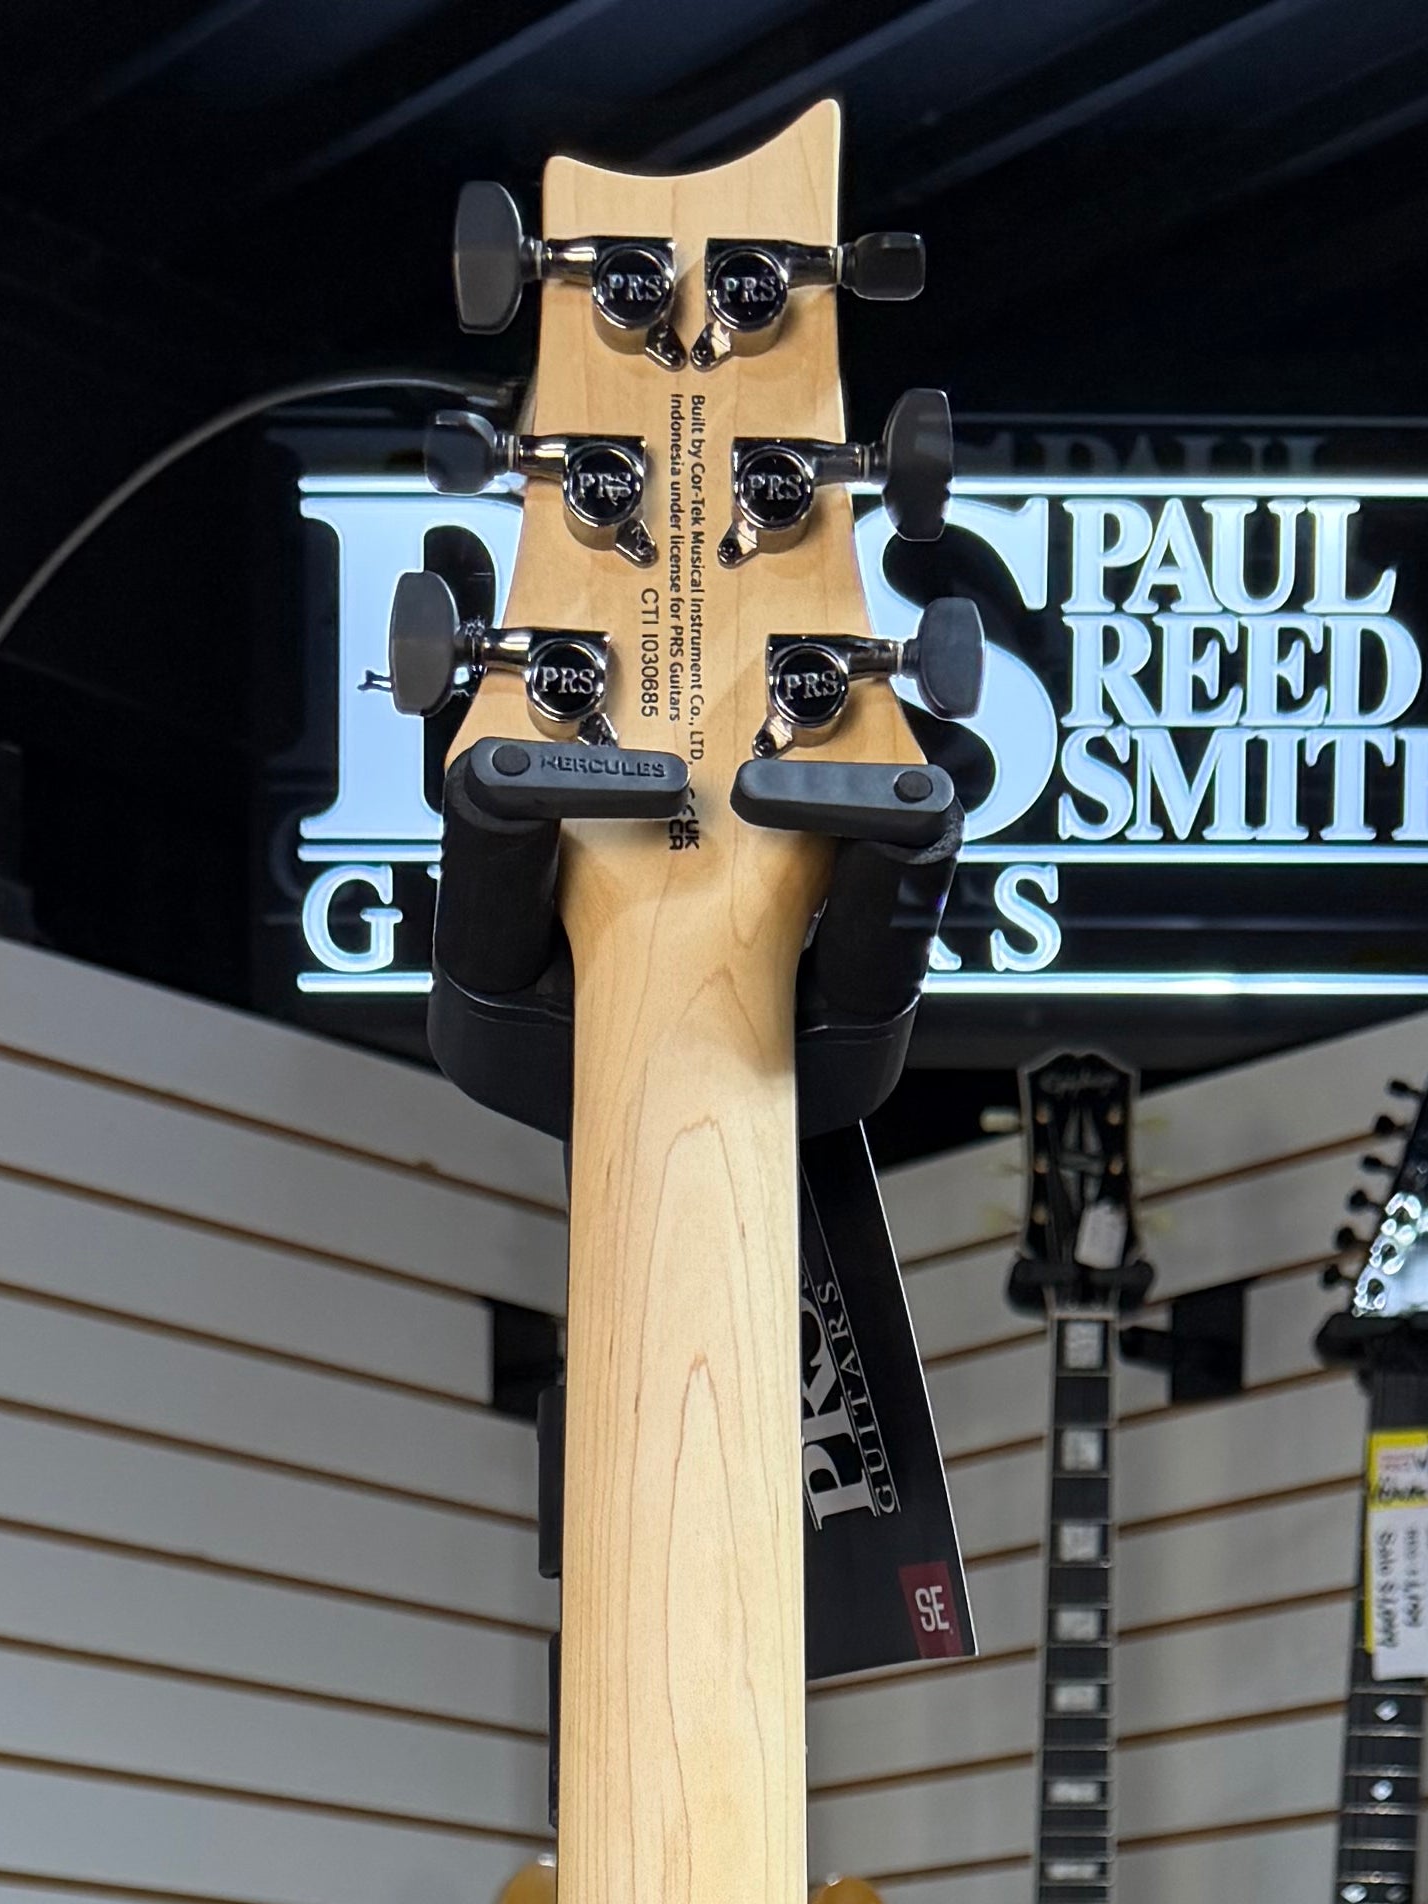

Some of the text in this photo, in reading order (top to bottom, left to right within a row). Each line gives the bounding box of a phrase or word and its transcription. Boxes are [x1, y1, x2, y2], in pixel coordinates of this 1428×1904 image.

[605, 274, 664, 302] PRS
[720, 275, 779, 304] PRS
[688, 394, 707, 434] Built
[685, 438, 705, 459] by
[688, 462, 706, 526] Cor-Tek
[746, 474, 803, 503] PRS
[669, 393, 685, 721] Indonesia under license for PRS Guitars
[688, 530, 706, 592] Musical
[1061, 497, 1398, 614] PAUL
[640, 587, 660, 624] CTI
[688, 597, 706, 689] Instrument
[538, 666, 596, 696] PRS
[783, 670, 841, 700] PRS
[1061, 613, 1424, 728] REED
[538, 753, 668, 779] HERCULES
[817, 1280, 895, 1514] GUITARS
[914, 1584, 951, 1634] SE
